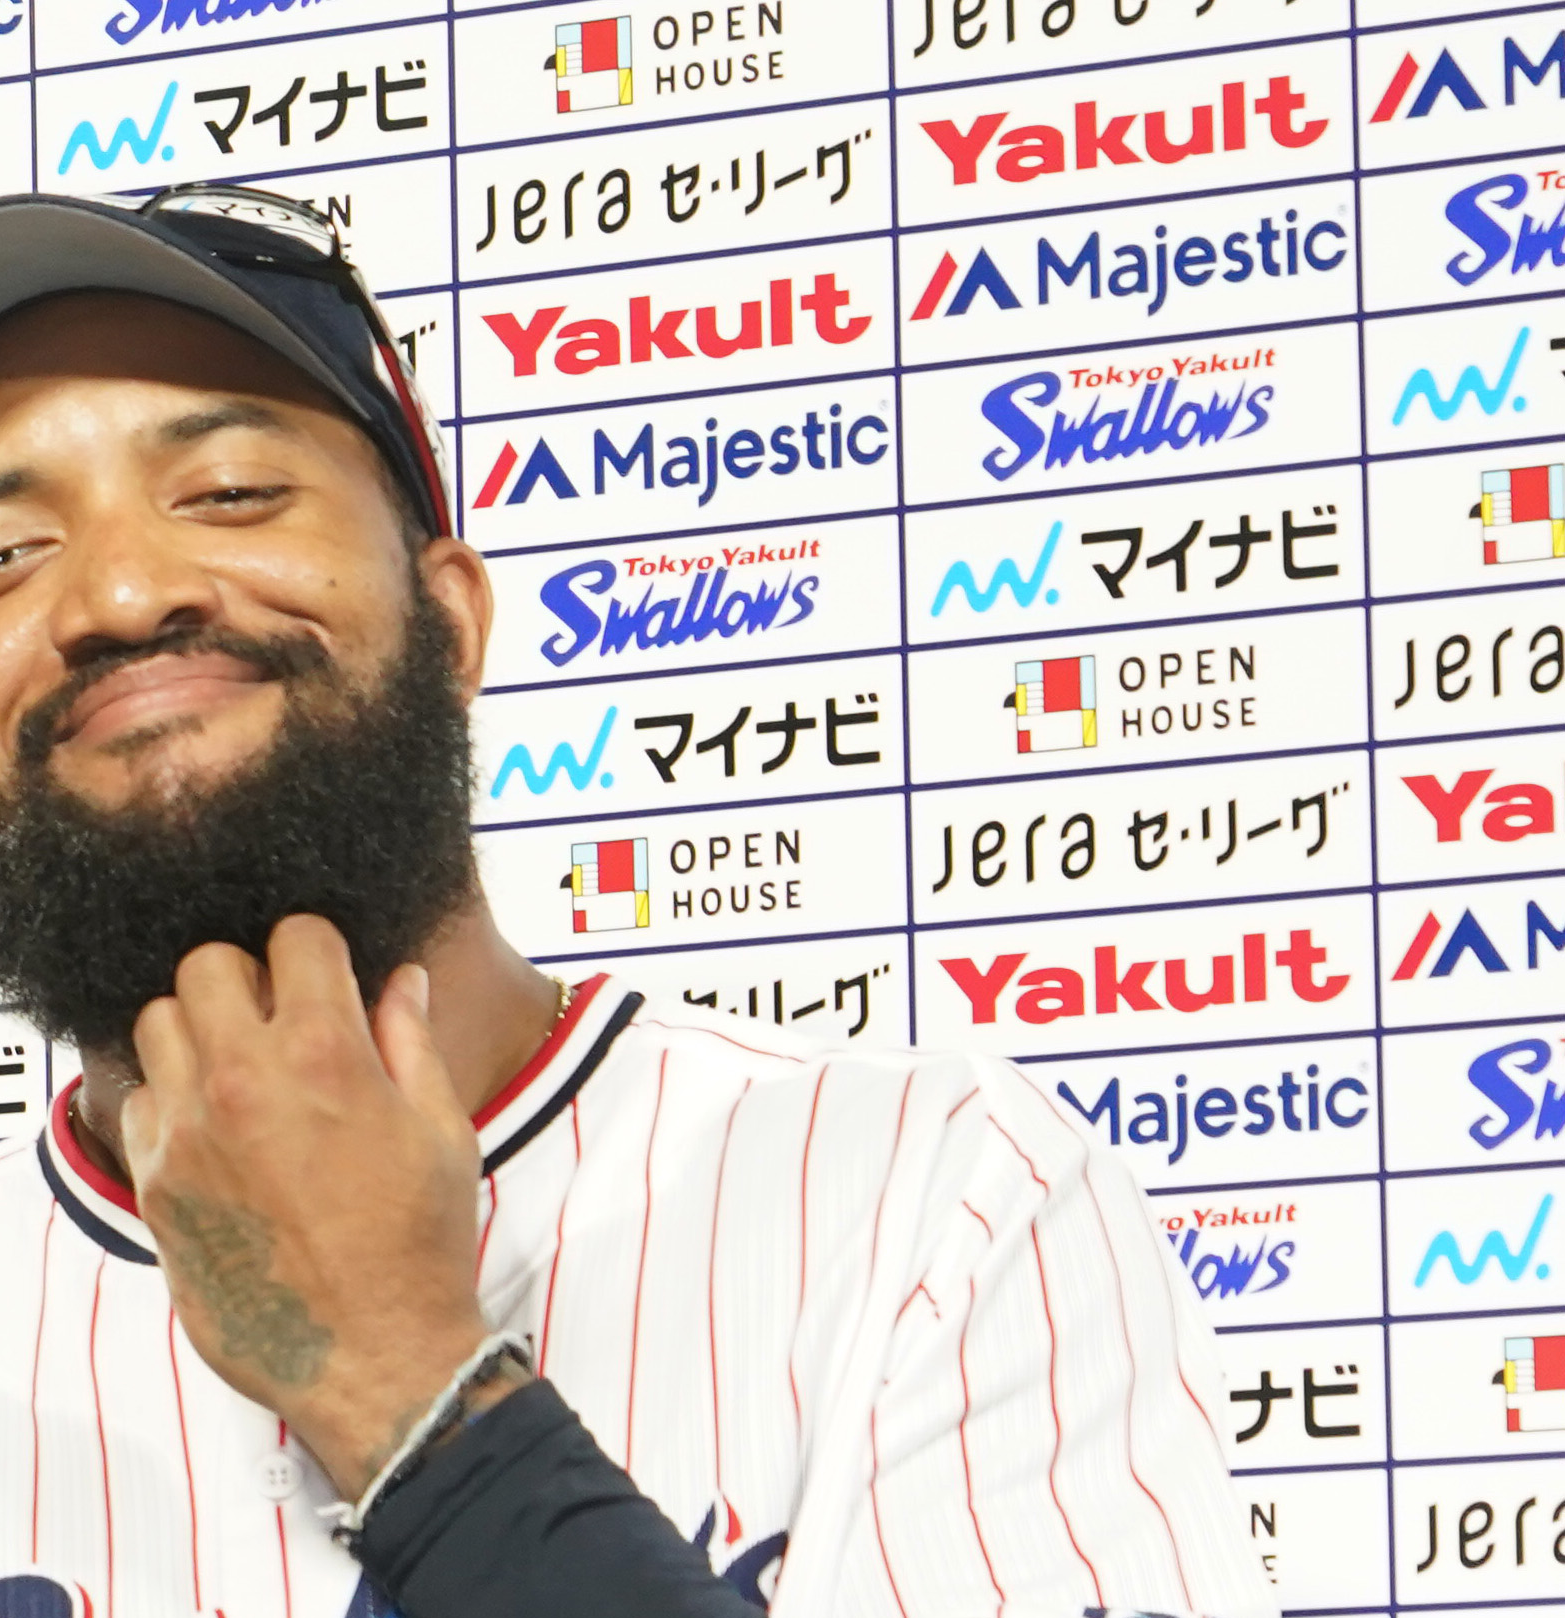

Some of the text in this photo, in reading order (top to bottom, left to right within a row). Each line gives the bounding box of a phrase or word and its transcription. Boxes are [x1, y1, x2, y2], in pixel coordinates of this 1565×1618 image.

[653, 1, 782, 50] OPEN
[194, 59, 428, 154] マイナビ
[656, 51, 783, 95] HOUSE
[918, 74, 1331, 187] Yakult
[1036, 210, 1345, 314] Majestic
[480, 272, 874, 378] Yakult
[1067, 348, 1276, 389] Tokyo Yakult
[592, 404, 886, 506] Majestic
[980, 371, 1274, 482] Swallows
[622, 539, 821, 578] Tokyo Yakult
[1081, 504, 1339, 599] マイナビ
[538, 559, 819, 668] Swallows
[1119, 645, 1254, 692] OPEN
[634, 692, 881, 783] マイナビ
[1122, 697, 1255, 737] HOUSE
[670, 829, 800, 874] OPEN
[673, 880, 801, 919] HOUSE
[937, 928, 1352, 1026] Yakult
[1192, 1203, 1297, 1229] Yakult
